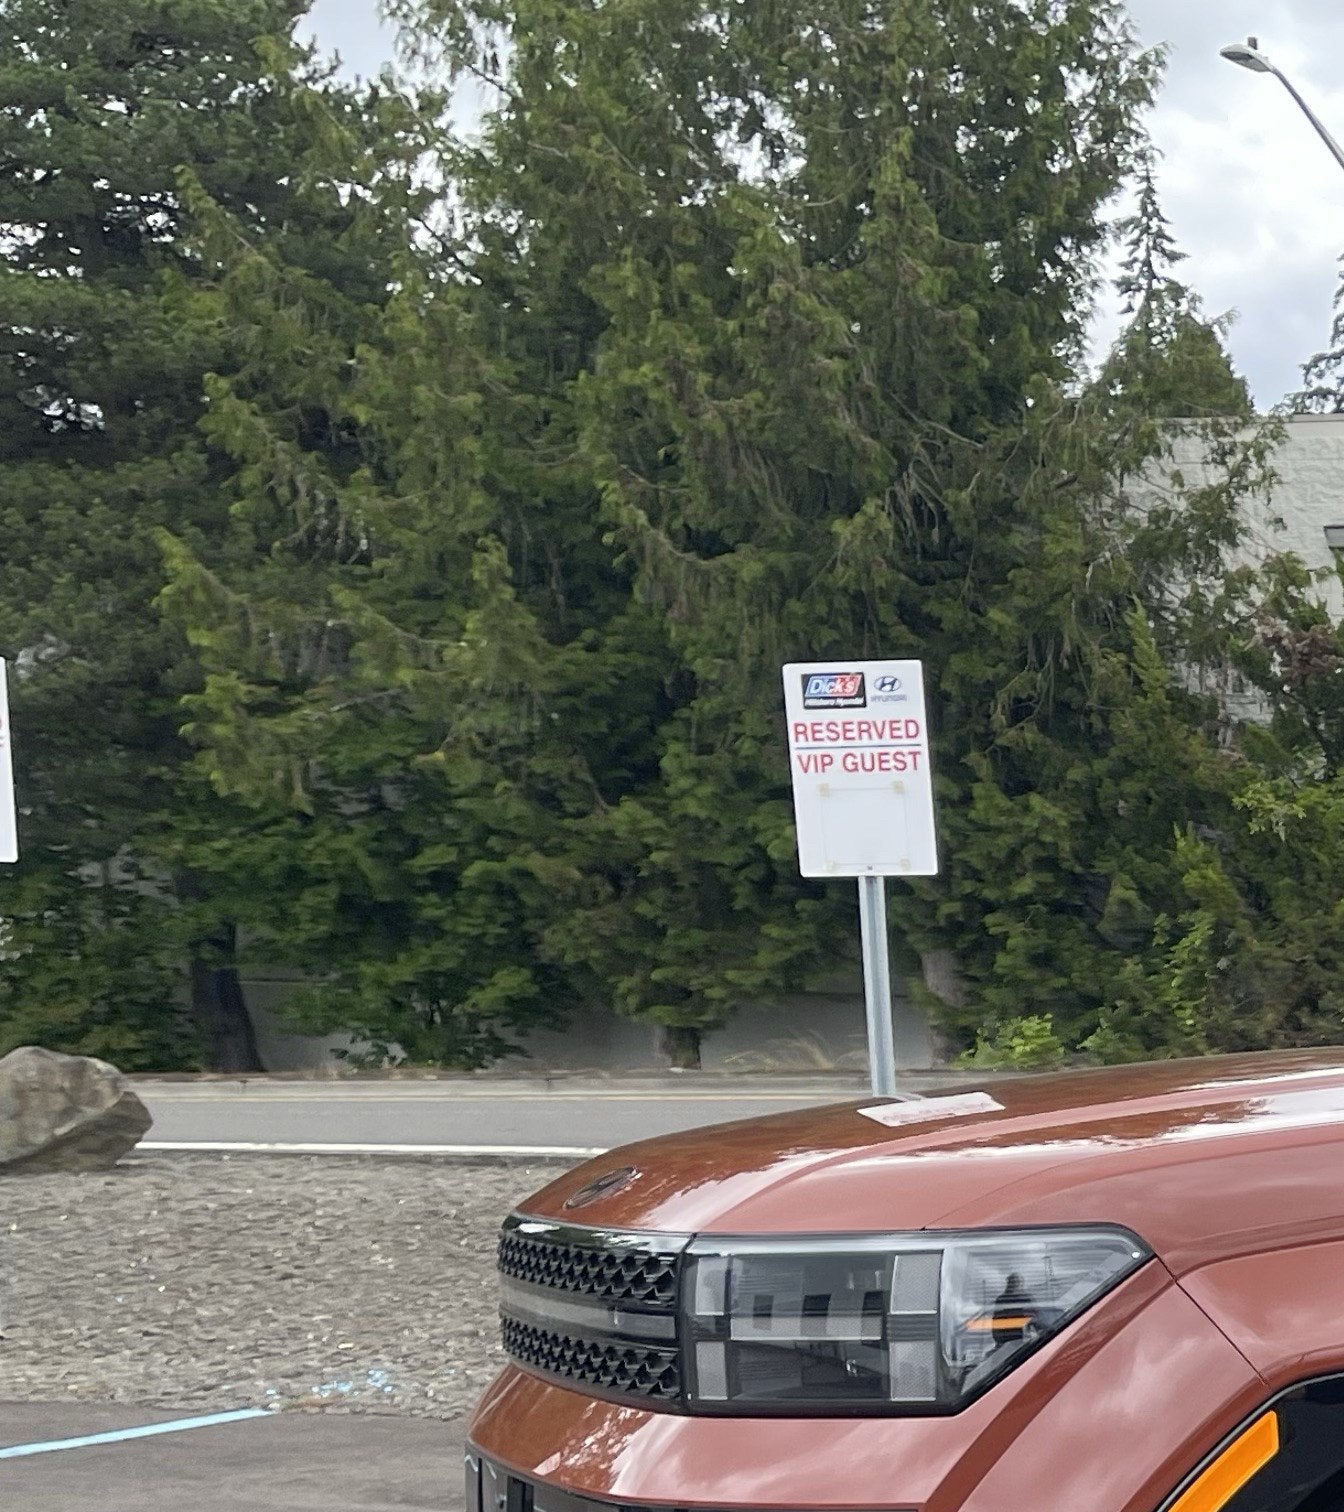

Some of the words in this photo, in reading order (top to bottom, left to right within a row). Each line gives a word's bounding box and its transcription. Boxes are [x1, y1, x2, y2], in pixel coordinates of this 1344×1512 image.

[794, 719, 920, 743] RESERVED
[797, 754, 834, 774] VIP
[842, 751, 922, 773] GUEST
